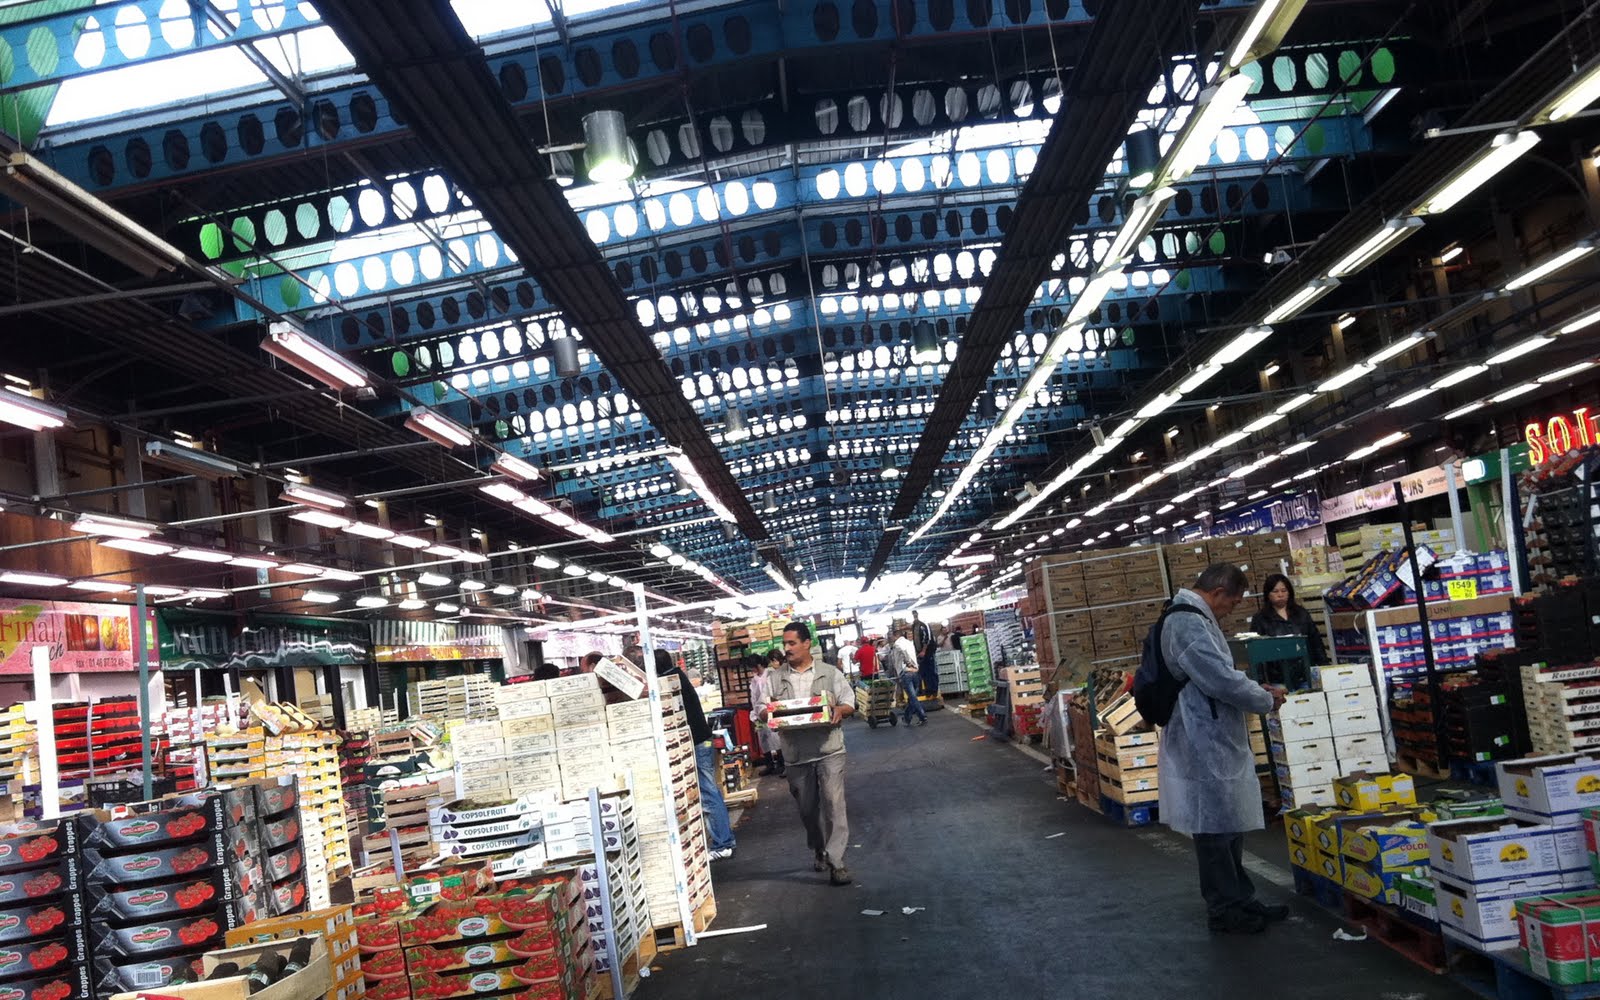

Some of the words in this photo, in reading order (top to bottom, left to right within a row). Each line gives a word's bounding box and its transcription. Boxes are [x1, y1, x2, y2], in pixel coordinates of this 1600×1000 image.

[1451, 581, 1471, 589] 1549
[0, 612, 57, 643] Final
[29, 629, 64, 667] tch
[214, 798, 223, 830] Grappes
[461, 807, 507, 820] COPSOLFRUIT
[66, 822, 76, 854] Grappes
[464, 824, 509, 836] COPSOLFRUIT
[471, 837, 518, 851] COPSOLFRUIT
[215, 833, 224, 865] Grappes
[69, 857, 78, 890] Grappes
[223, 868, 232, 900] Grappes
[73, 893, 82, 926] Grappes
[226, 904, 235, 931] rappes
[76, 929, 85, 961] Grappes
[79, 965, 89, 999] Grappes
